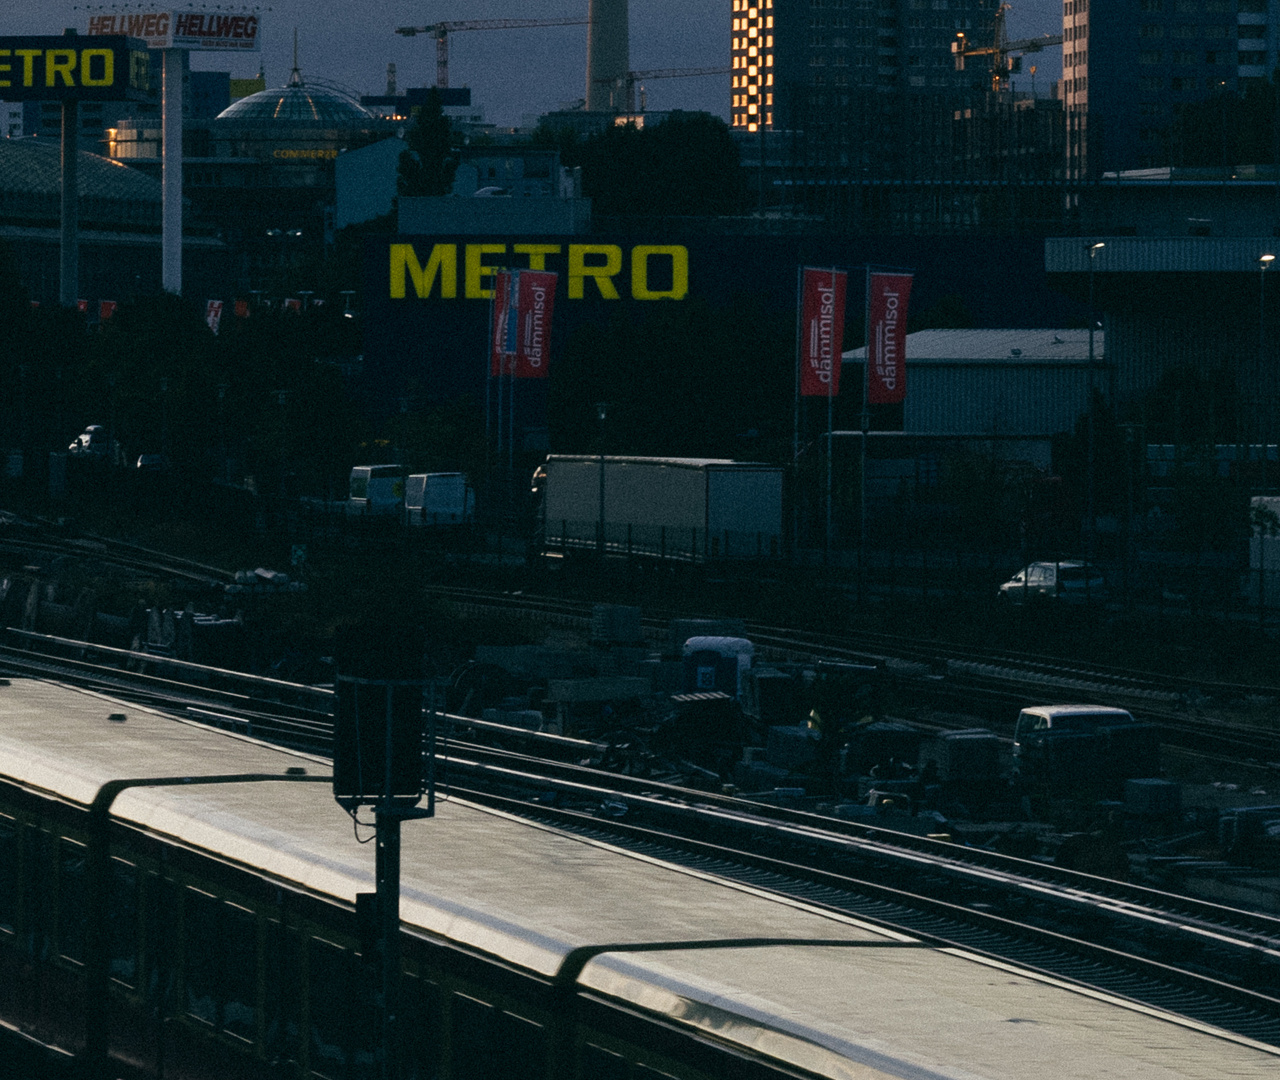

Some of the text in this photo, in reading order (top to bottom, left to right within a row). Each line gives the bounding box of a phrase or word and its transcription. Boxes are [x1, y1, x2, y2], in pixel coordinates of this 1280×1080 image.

[89, 13, 169, 36] HELLWEG
[175, 15, 257, 38] HELLWEG
[389, 243, 689, 300] METRO
